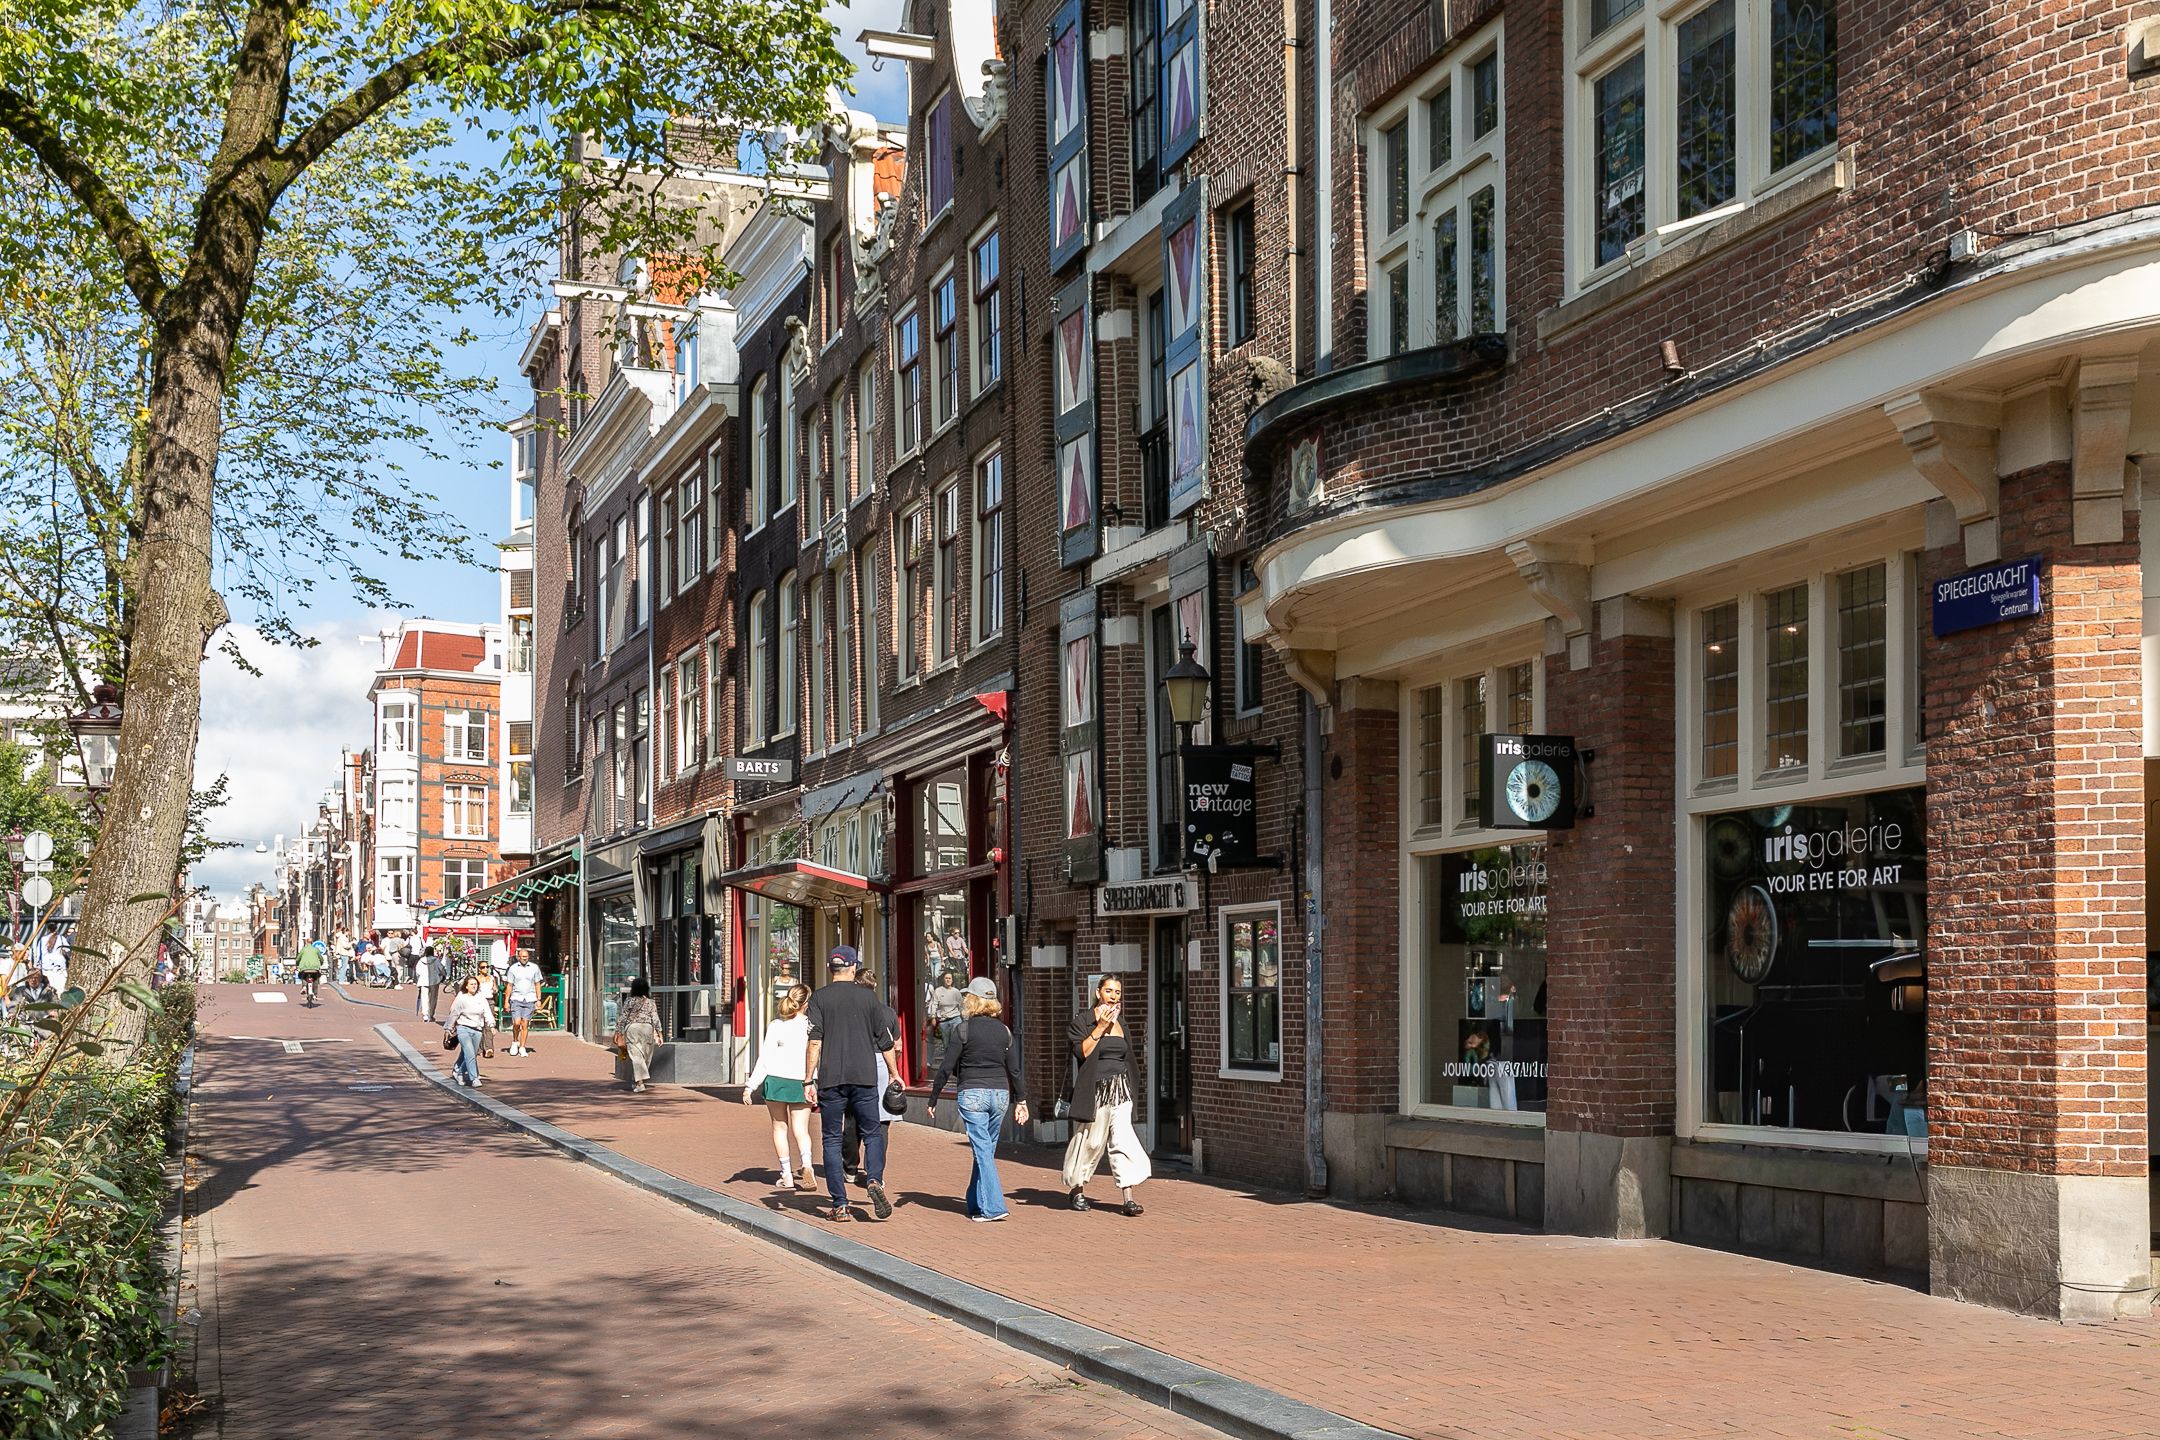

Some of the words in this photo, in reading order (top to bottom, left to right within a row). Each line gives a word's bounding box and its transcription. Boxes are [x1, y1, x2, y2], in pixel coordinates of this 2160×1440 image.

[1938, 564, 2029, 603] SPIEGELGRACHT
[2000, 603, 2029, 617] Centrum
[1188, 783, 1230, 796] new
[1189, 796, 1252, 817] vntage
[1767, 874, 1805, 894] YOUR
[1809, 871, 1834, 891] EYE
[1838, 868, 1868, 889] FOR
[1872, 864, 1902, 886] ART
[1103, 883, 1171, 911] SPIEGELGRACHT
[1174, 882, 1184, 908] 13
[1461, 902, 1486, 917] YOUR
[1488, 900, 1504, 915] EYE
[1506, 898, 1525, 914] FOR
[1528, 895, 1547, 912] ART
[1442, 1062, 1470, 1077] JOUW
[1472, 1062, 1494, 1077] OOG
